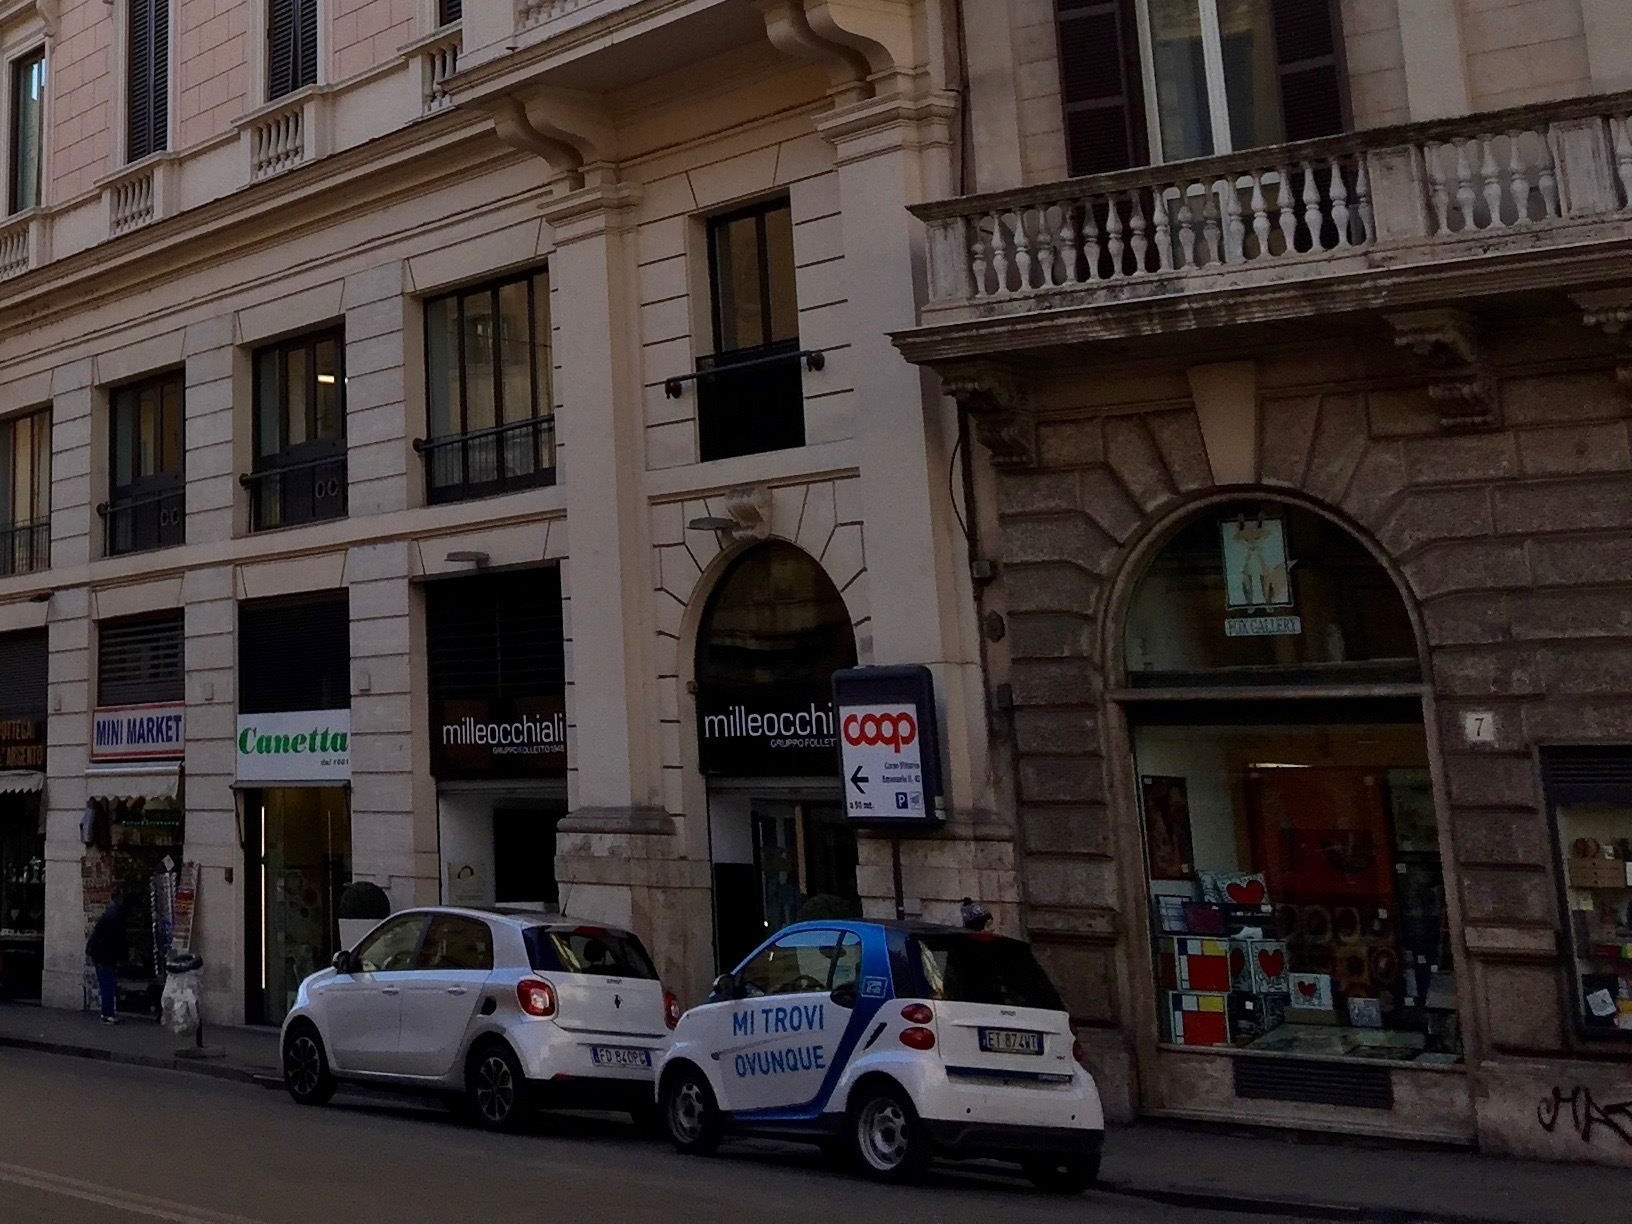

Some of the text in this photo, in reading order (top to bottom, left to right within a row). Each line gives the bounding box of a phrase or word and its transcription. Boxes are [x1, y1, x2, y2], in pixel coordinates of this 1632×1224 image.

[96, 714, 182, 746] MINI MARKET
[442, 712, 565, 745] milleocchiali
[705, 702, 834, 738] milleocchi
[844, 712, 916, 753] coop
[1474, 717, 1484, 737] 7
[238, 726, 349, 755] Canetta
[770, 737, 838, 749] GRUPPO FOLLET
[733, 1004, 824, 1036] MI TROVI
[987, 1032, 1001, 1048] ET
[735, 1045, 826, 1077] OVUNQUE
